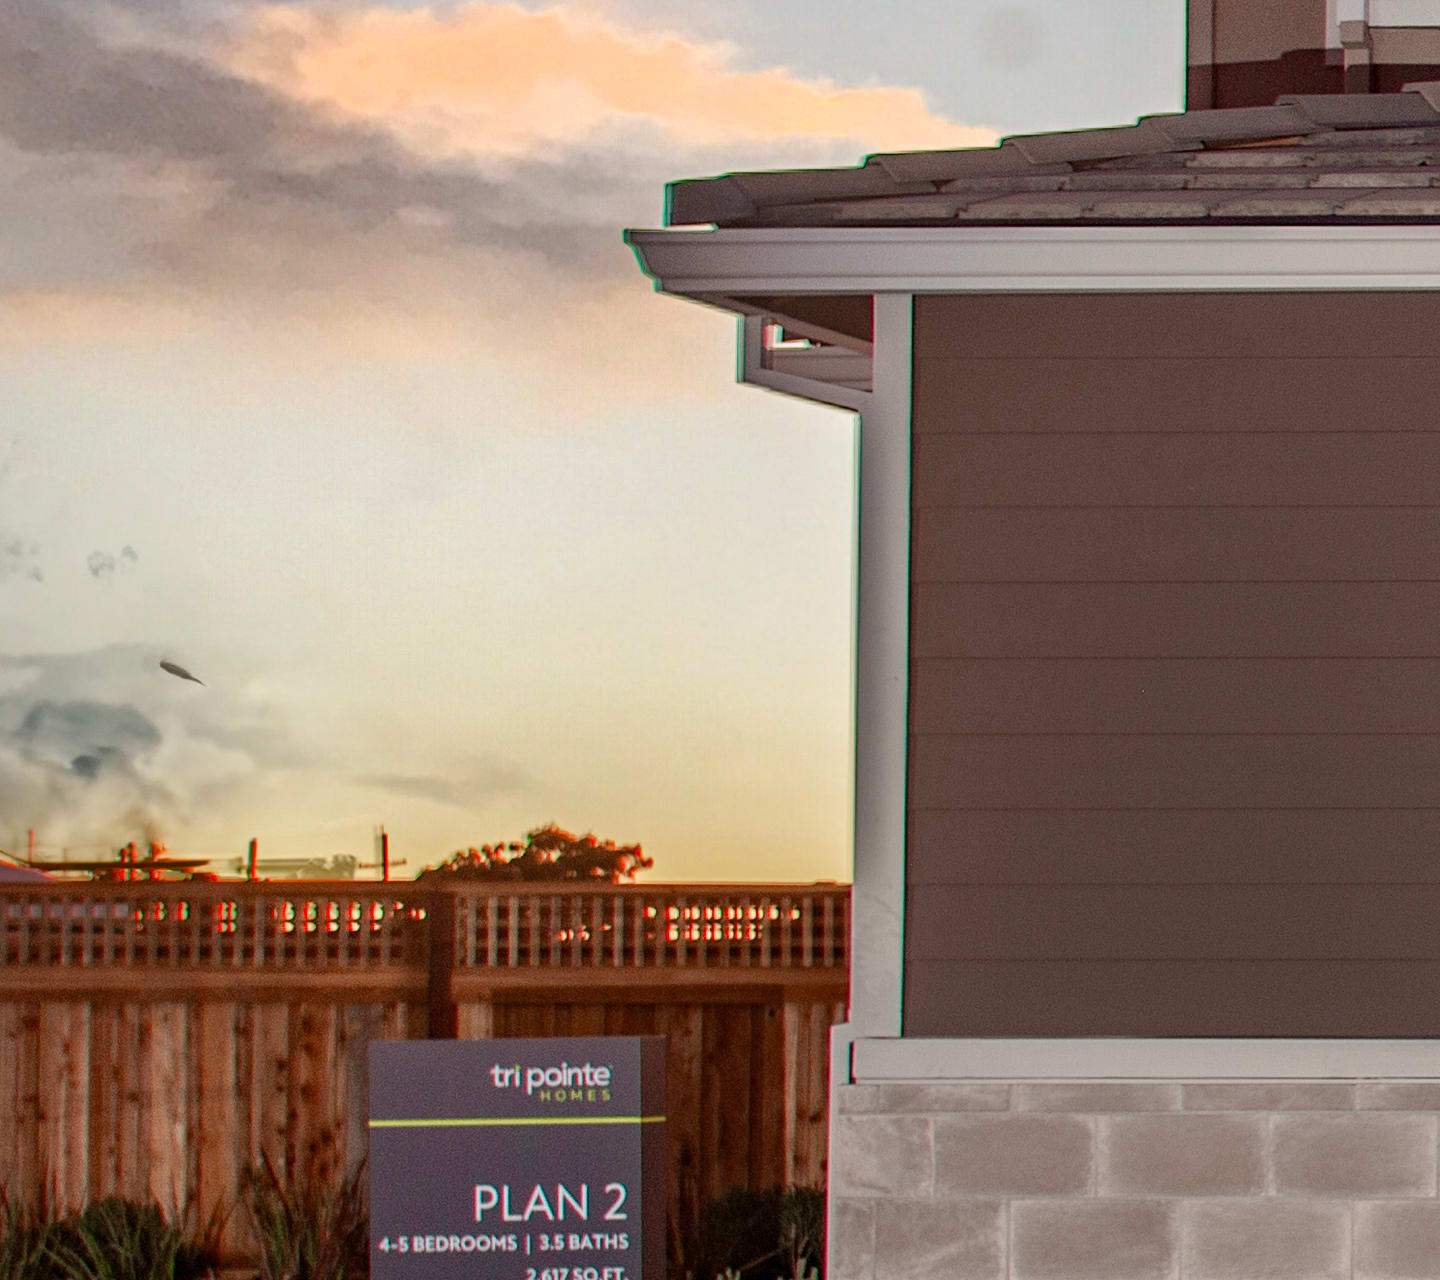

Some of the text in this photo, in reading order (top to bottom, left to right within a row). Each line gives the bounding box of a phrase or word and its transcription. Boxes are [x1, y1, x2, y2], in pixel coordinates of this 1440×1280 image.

[489, 1061, 612, 1096] tri pointe
[539, 1088, 612, 1103] HOMES
[472, 1182, 629, 1222] PLAN 2
[378, 1235, 409, 1254] 4-5
[411, 1234, 518, 1254] BEDROOMS
[538, 1233, 565, 1252] 3.5
[567, 1232, 630, 1252] BATHS
